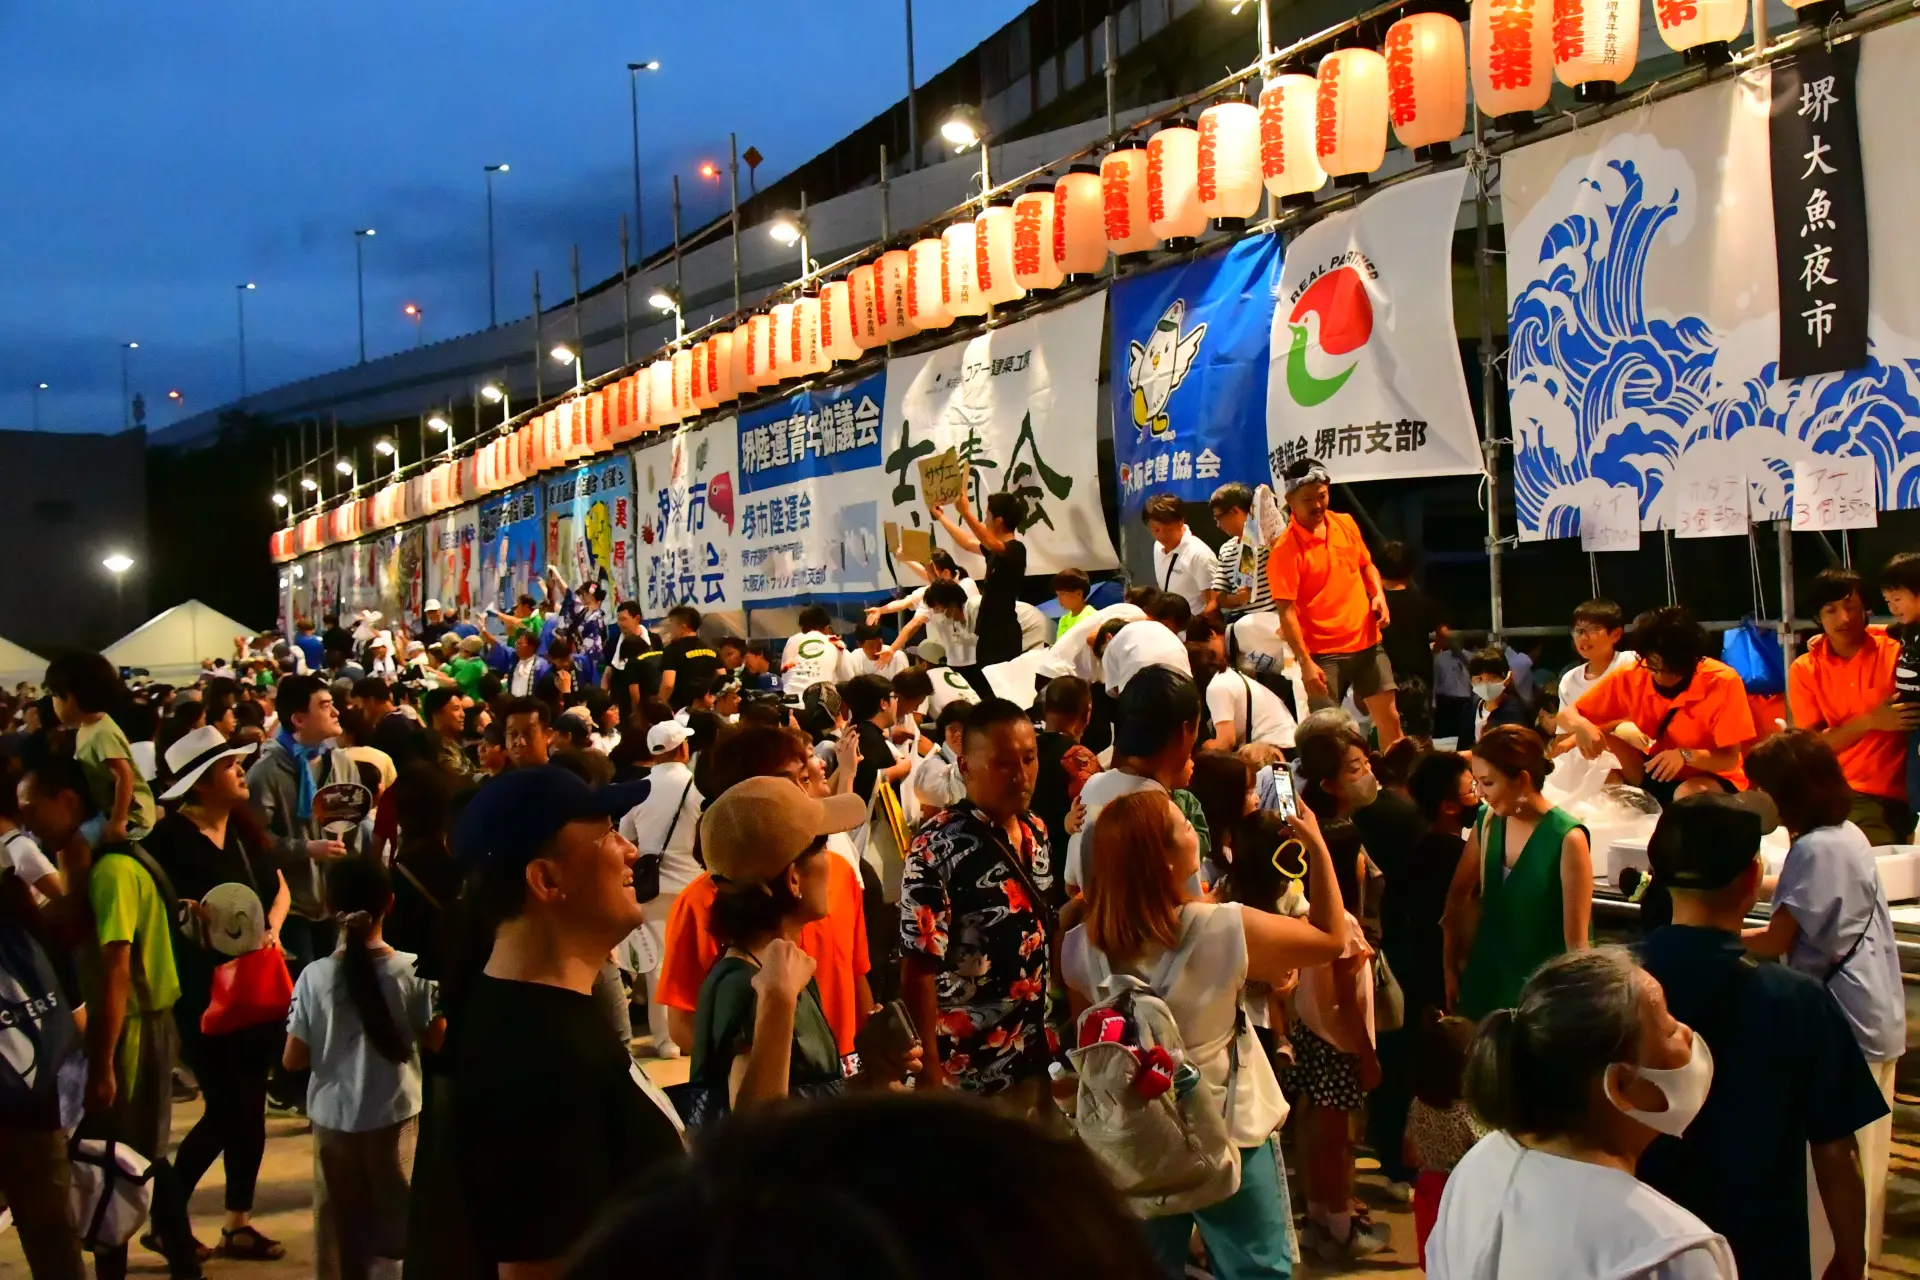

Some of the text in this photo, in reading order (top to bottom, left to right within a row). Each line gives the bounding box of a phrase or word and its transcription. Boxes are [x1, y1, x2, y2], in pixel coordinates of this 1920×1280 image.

[1797, 75, 1840, 348] 堺大魚夜市
[1290, 264, 1327, 304] REAL
[1314, 418, 1428, 460] 堺市支部
